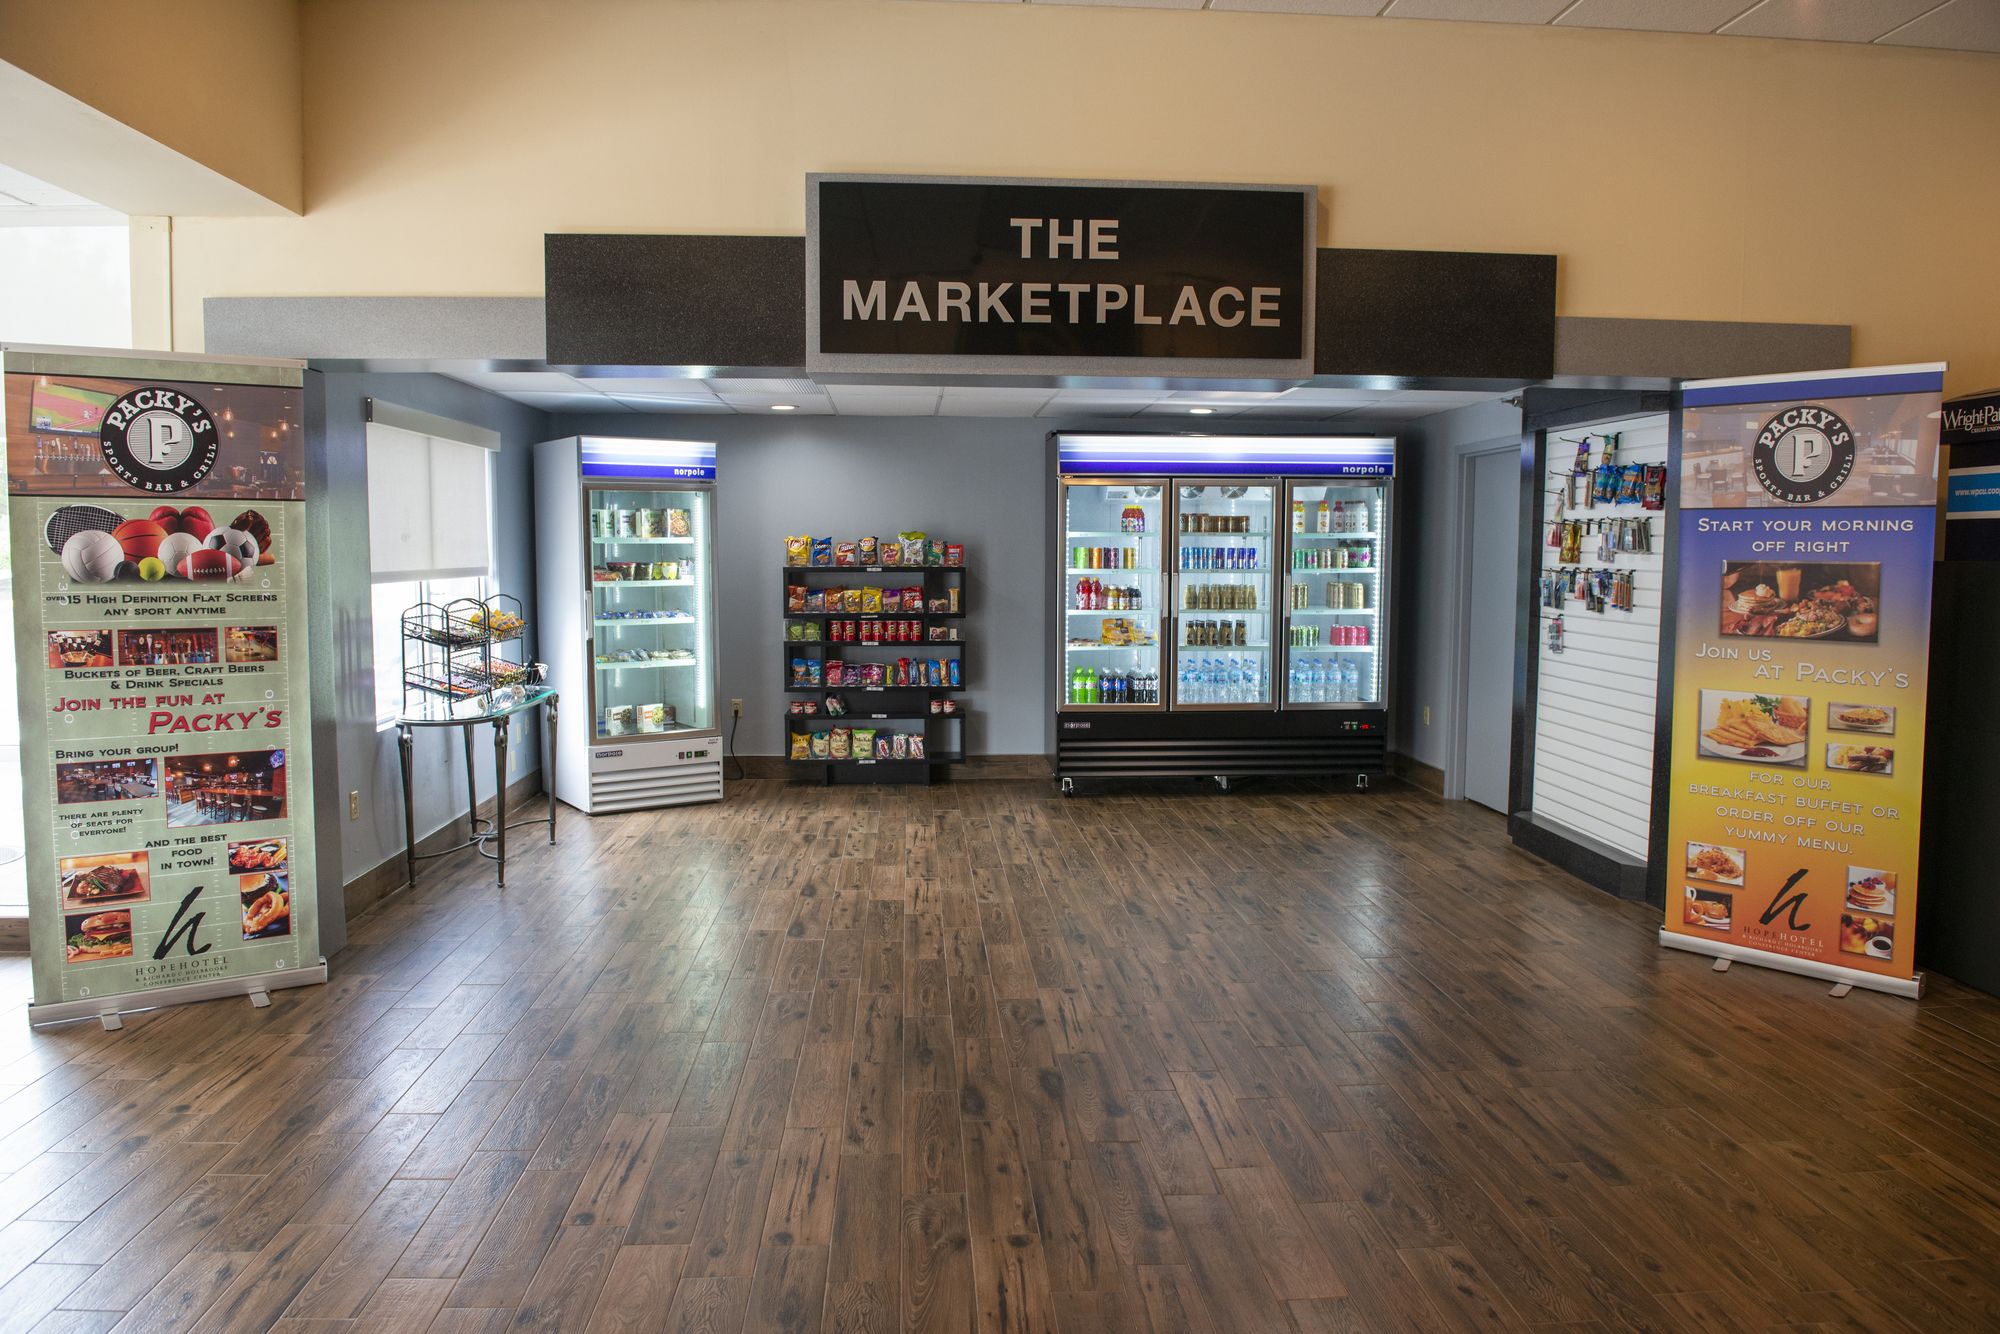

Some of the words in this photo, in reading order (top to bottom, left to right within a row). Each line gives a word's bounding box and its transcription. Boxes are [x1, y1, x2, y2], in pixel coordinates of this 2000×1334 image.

[1010, 218, 1120, 260] THE
[842, 280, 1281, 328] MARKETPLACE
[107, 390, 212, 434] PACKY'S
[1759, 408, 1849, 449] PACKY'S
[103, 441, 139, 485] SPORTS
[145, 481, 174, 492] BAR
[180, 480, 189, 488] &
[193, 442, 217, 480] GRILL
[674, 468, 705, 477] norpole
[1342, 464, 1385, 474] norpole
[1755, 458, 1782, 497] SPORTS
[1787, 493, 1812, 502] BAR
[1818, 490, 1825, 498] &
[1830, 454, 1853, 489] GRILL
[1698, 518, 1754, 532] START
[1762, 519, 1812, 532] YOUR
[1822, 519, 1914, 532] MORNING
[1752, 541, 1786, 553] OFF
[1794, 541, 1850, 553] RIGHT
[68, 594, 81, 604] 15
[86, 593, 118, 605] HIGH
[122, 593, 189, 604] DEFINITION
[193, 592, 222, 603] FLAT
[226, 591, 278, 603] SCREENS
[104, 607, 131, 616] ANY
[135, 606, 172, 616] SPORT
[176, 606, 226, 615] ANYTIME
[1695, 643, 1739, 661] JOIN
[1748, 648, 1772, 661] US
[65, 669, 121, 680] BUCKETS
[125, 668, 142, 678] OF
[185, 665, 225, 676] CRAFT
[228, 664, 265, 674] BEERS
[1754, 664, 1784, 679] AT
[1796, 663, 1909, 689] PACKY'S
[111, 681, 121, 690] &
[125, 679, 164, 689] DRINK
[169, 677, 224, 688] SPECIALS
[53, 697, 101, 712] JOIN
[110, 697, 147, 710] THE
[156, 694, 194, 707] FUN
[201, 693, 226, 705] AT
[147, 706, 283, 735] PACKY'S
[56, 749, 95, 759] BRING
[98, 747, 133, 756] YOUR
[136, 743, 180, 754] GROUP!
[1750, 771, 1784, 785] FOR
[1793, 776, 1831, 791] OUR
[1688, 783, 1787, 805] BREAKFAST
[1796, 796, 1863, 815] BUFFET
[1871, 805, 1899, 819] OR
[59, 812, 87, 821] THERE
[90, 811, 108, 819] ARE
[112, 809, 144, 818] PLENTY
[87, 819, 114, 828] SEATS
[116, 818, 134, 826] FOR
[1716, 806, 1774, 823] ORDER
[1783, 815, 1817, 829] OFF
[1825, 820, 1865, 835] OUR
[79, 826, 127, 837] EVERYONE!
[1724, 825, 1788, 844] YUMMY
[1797, 836, 1853, 854] MENU.
[145, 838, 171, 849] AND
[174, 837, 197, 846] THE
[200, 834, 228, 844] BEST
[171, 848, 203, 858] FOOD
[160, 862, 173, 870] IN
[177, 857, 214, 869] TOWN!
[135, 956, 230, 976] HOPEHOTEL
